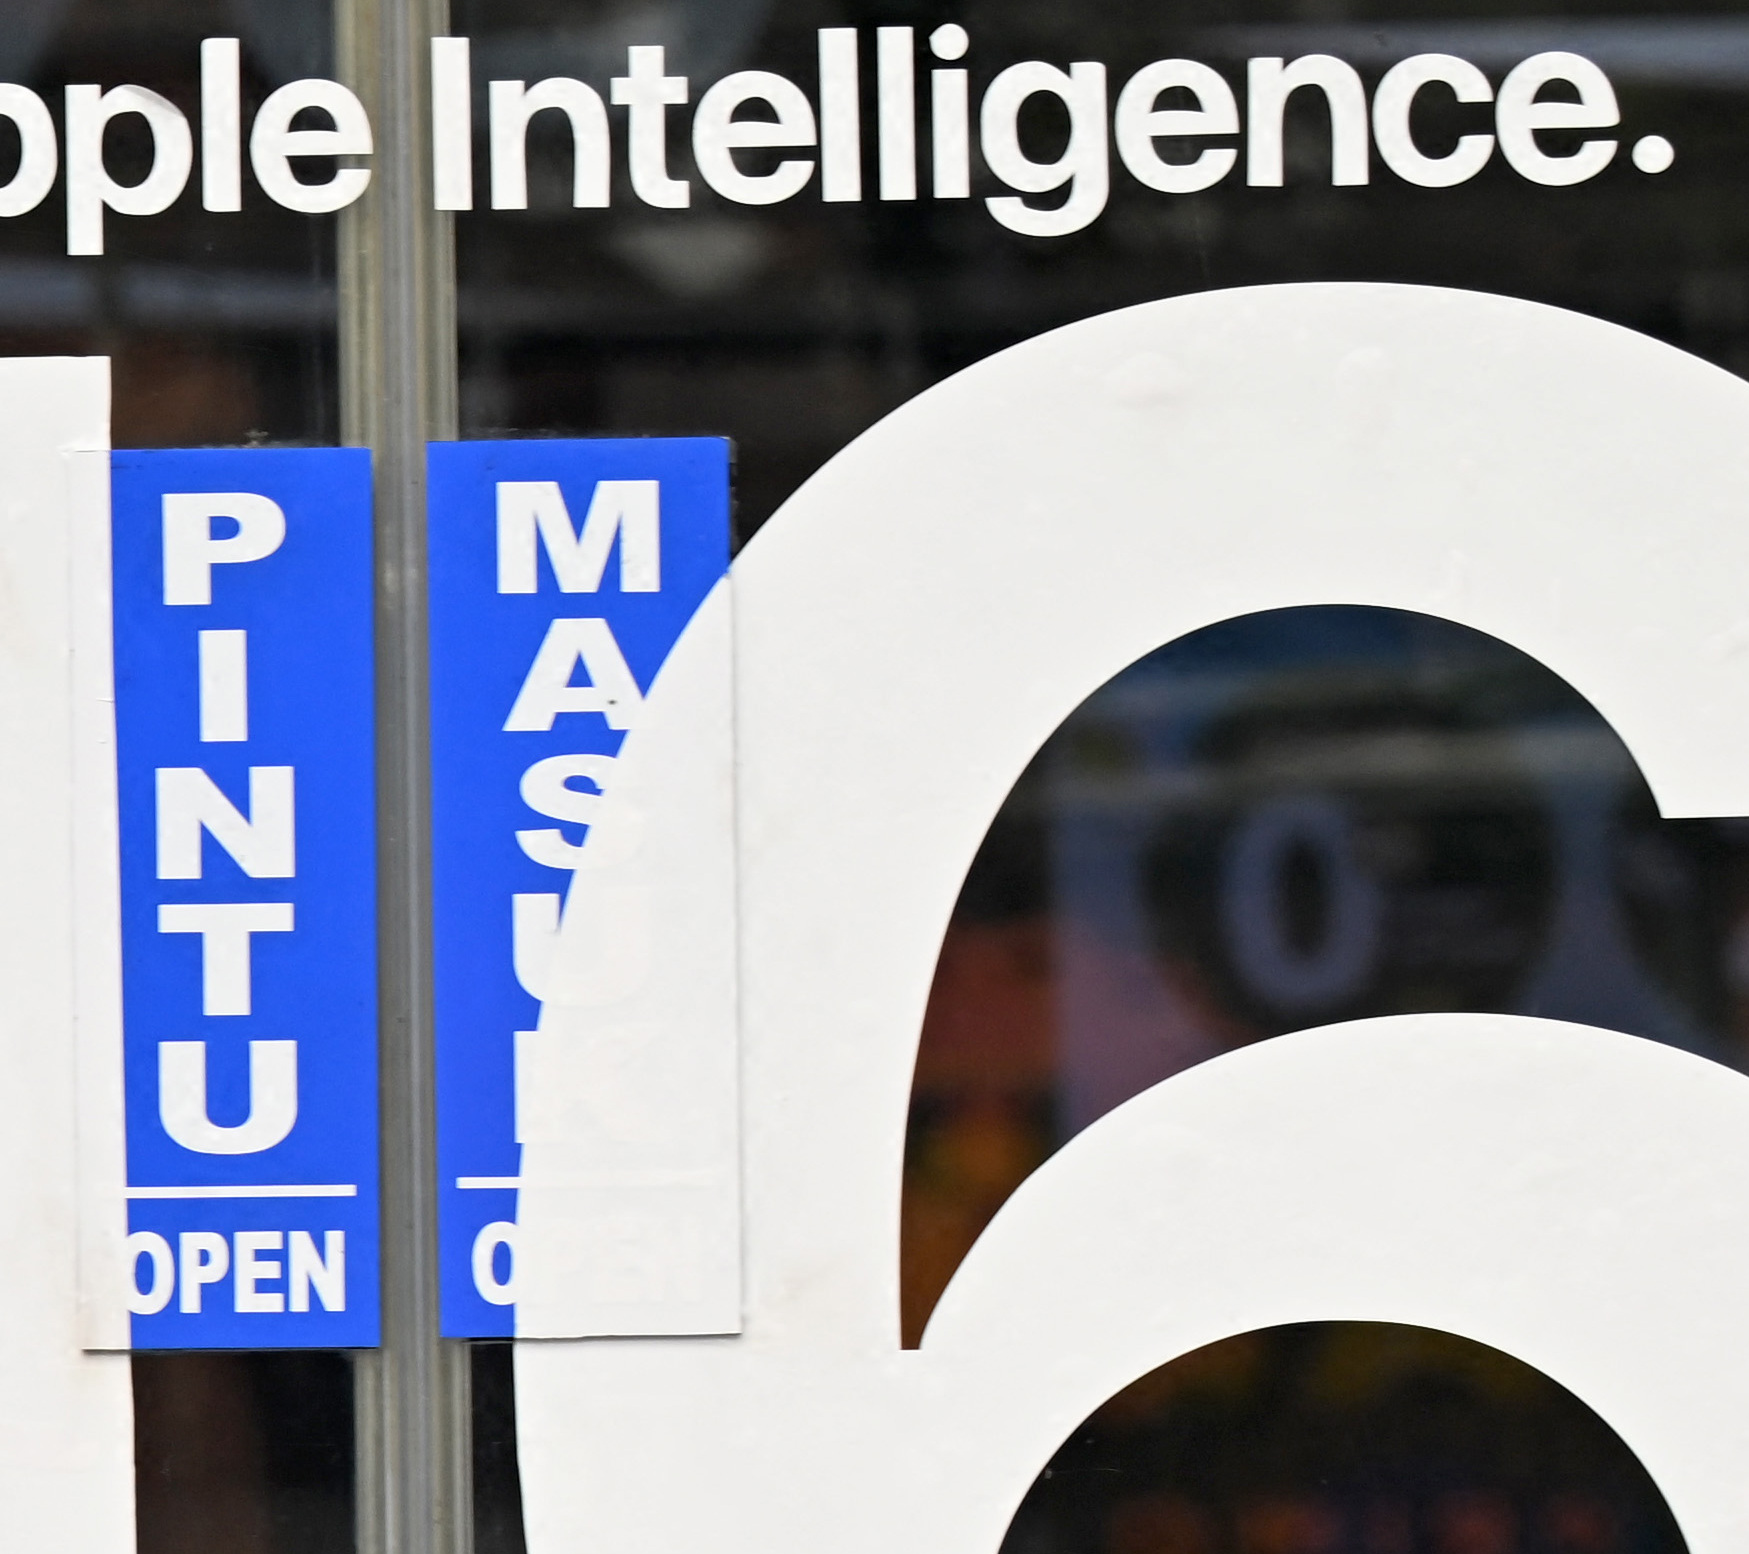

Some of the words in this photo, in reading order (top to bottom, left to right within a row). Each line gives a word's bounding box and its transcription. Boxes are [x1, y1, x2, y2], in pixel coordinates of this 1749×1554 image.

[431, 22, 1675, 238] Intelligence.
[153, 491, 298, 1156] PINTU
[126, 1229, 346, 1315] OPEN
